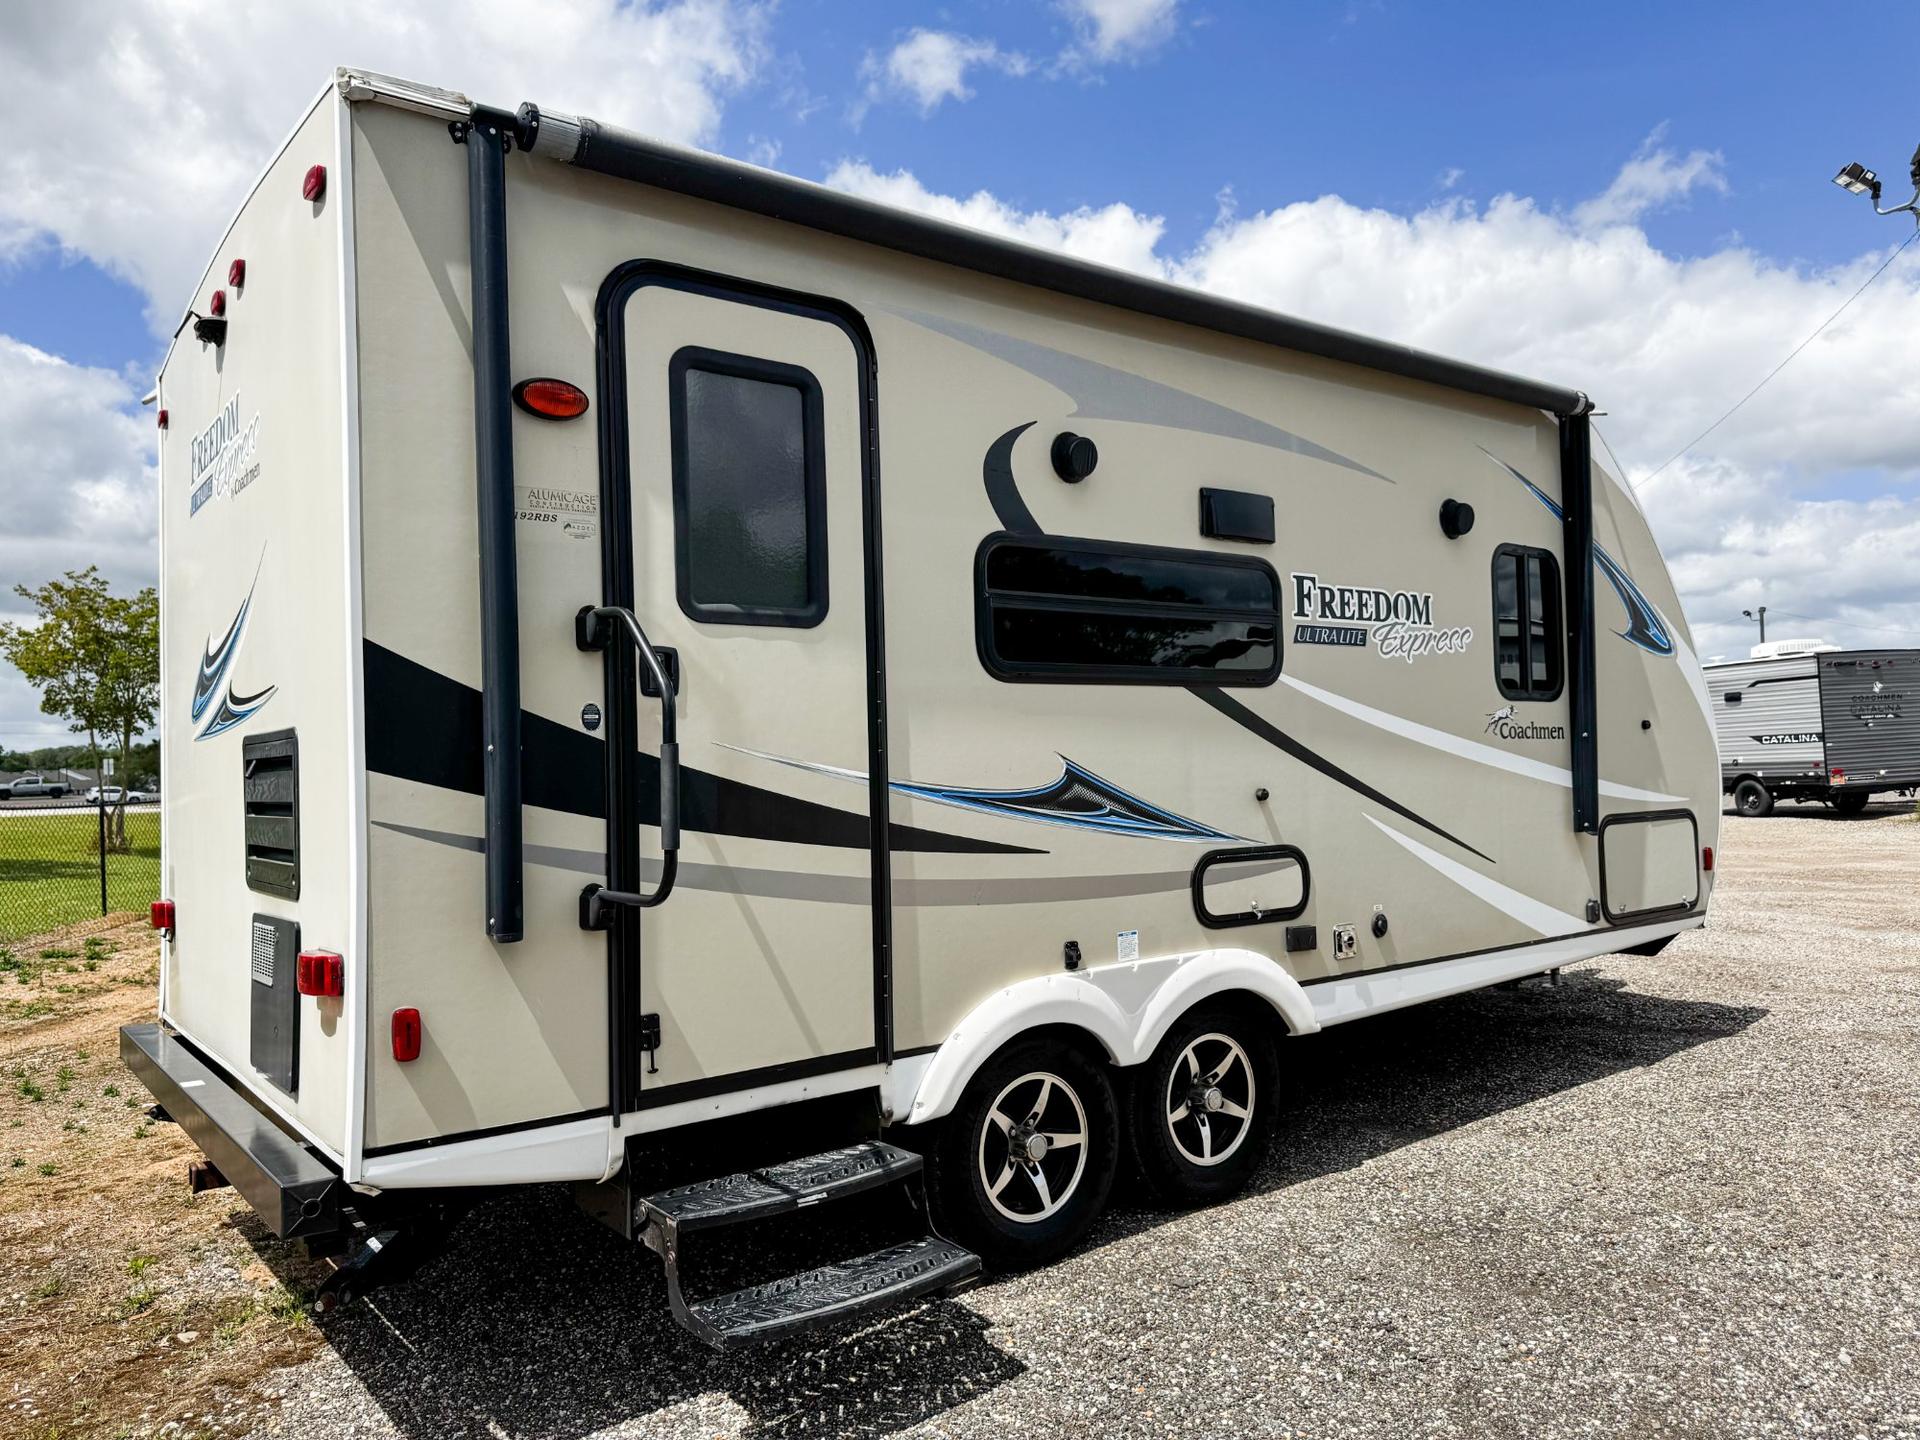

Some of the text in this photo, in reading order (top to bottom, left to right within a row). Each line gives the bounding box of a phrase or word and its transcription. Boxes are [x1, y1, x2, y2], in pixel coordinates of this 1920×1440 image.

[191, 392, 240, 487] FREEDOM
[528, 489, 597, 505] ALUMICAGE
[529, 500, 597, 511] CONSTRUCTION
[1292, 574, 1432, 626] FREEDOM
[1372, 622, 1472, 663] Express
[1499, 721, 1565, 740] Coachmen
[1762, 734, 1819, 744] CATALINA
